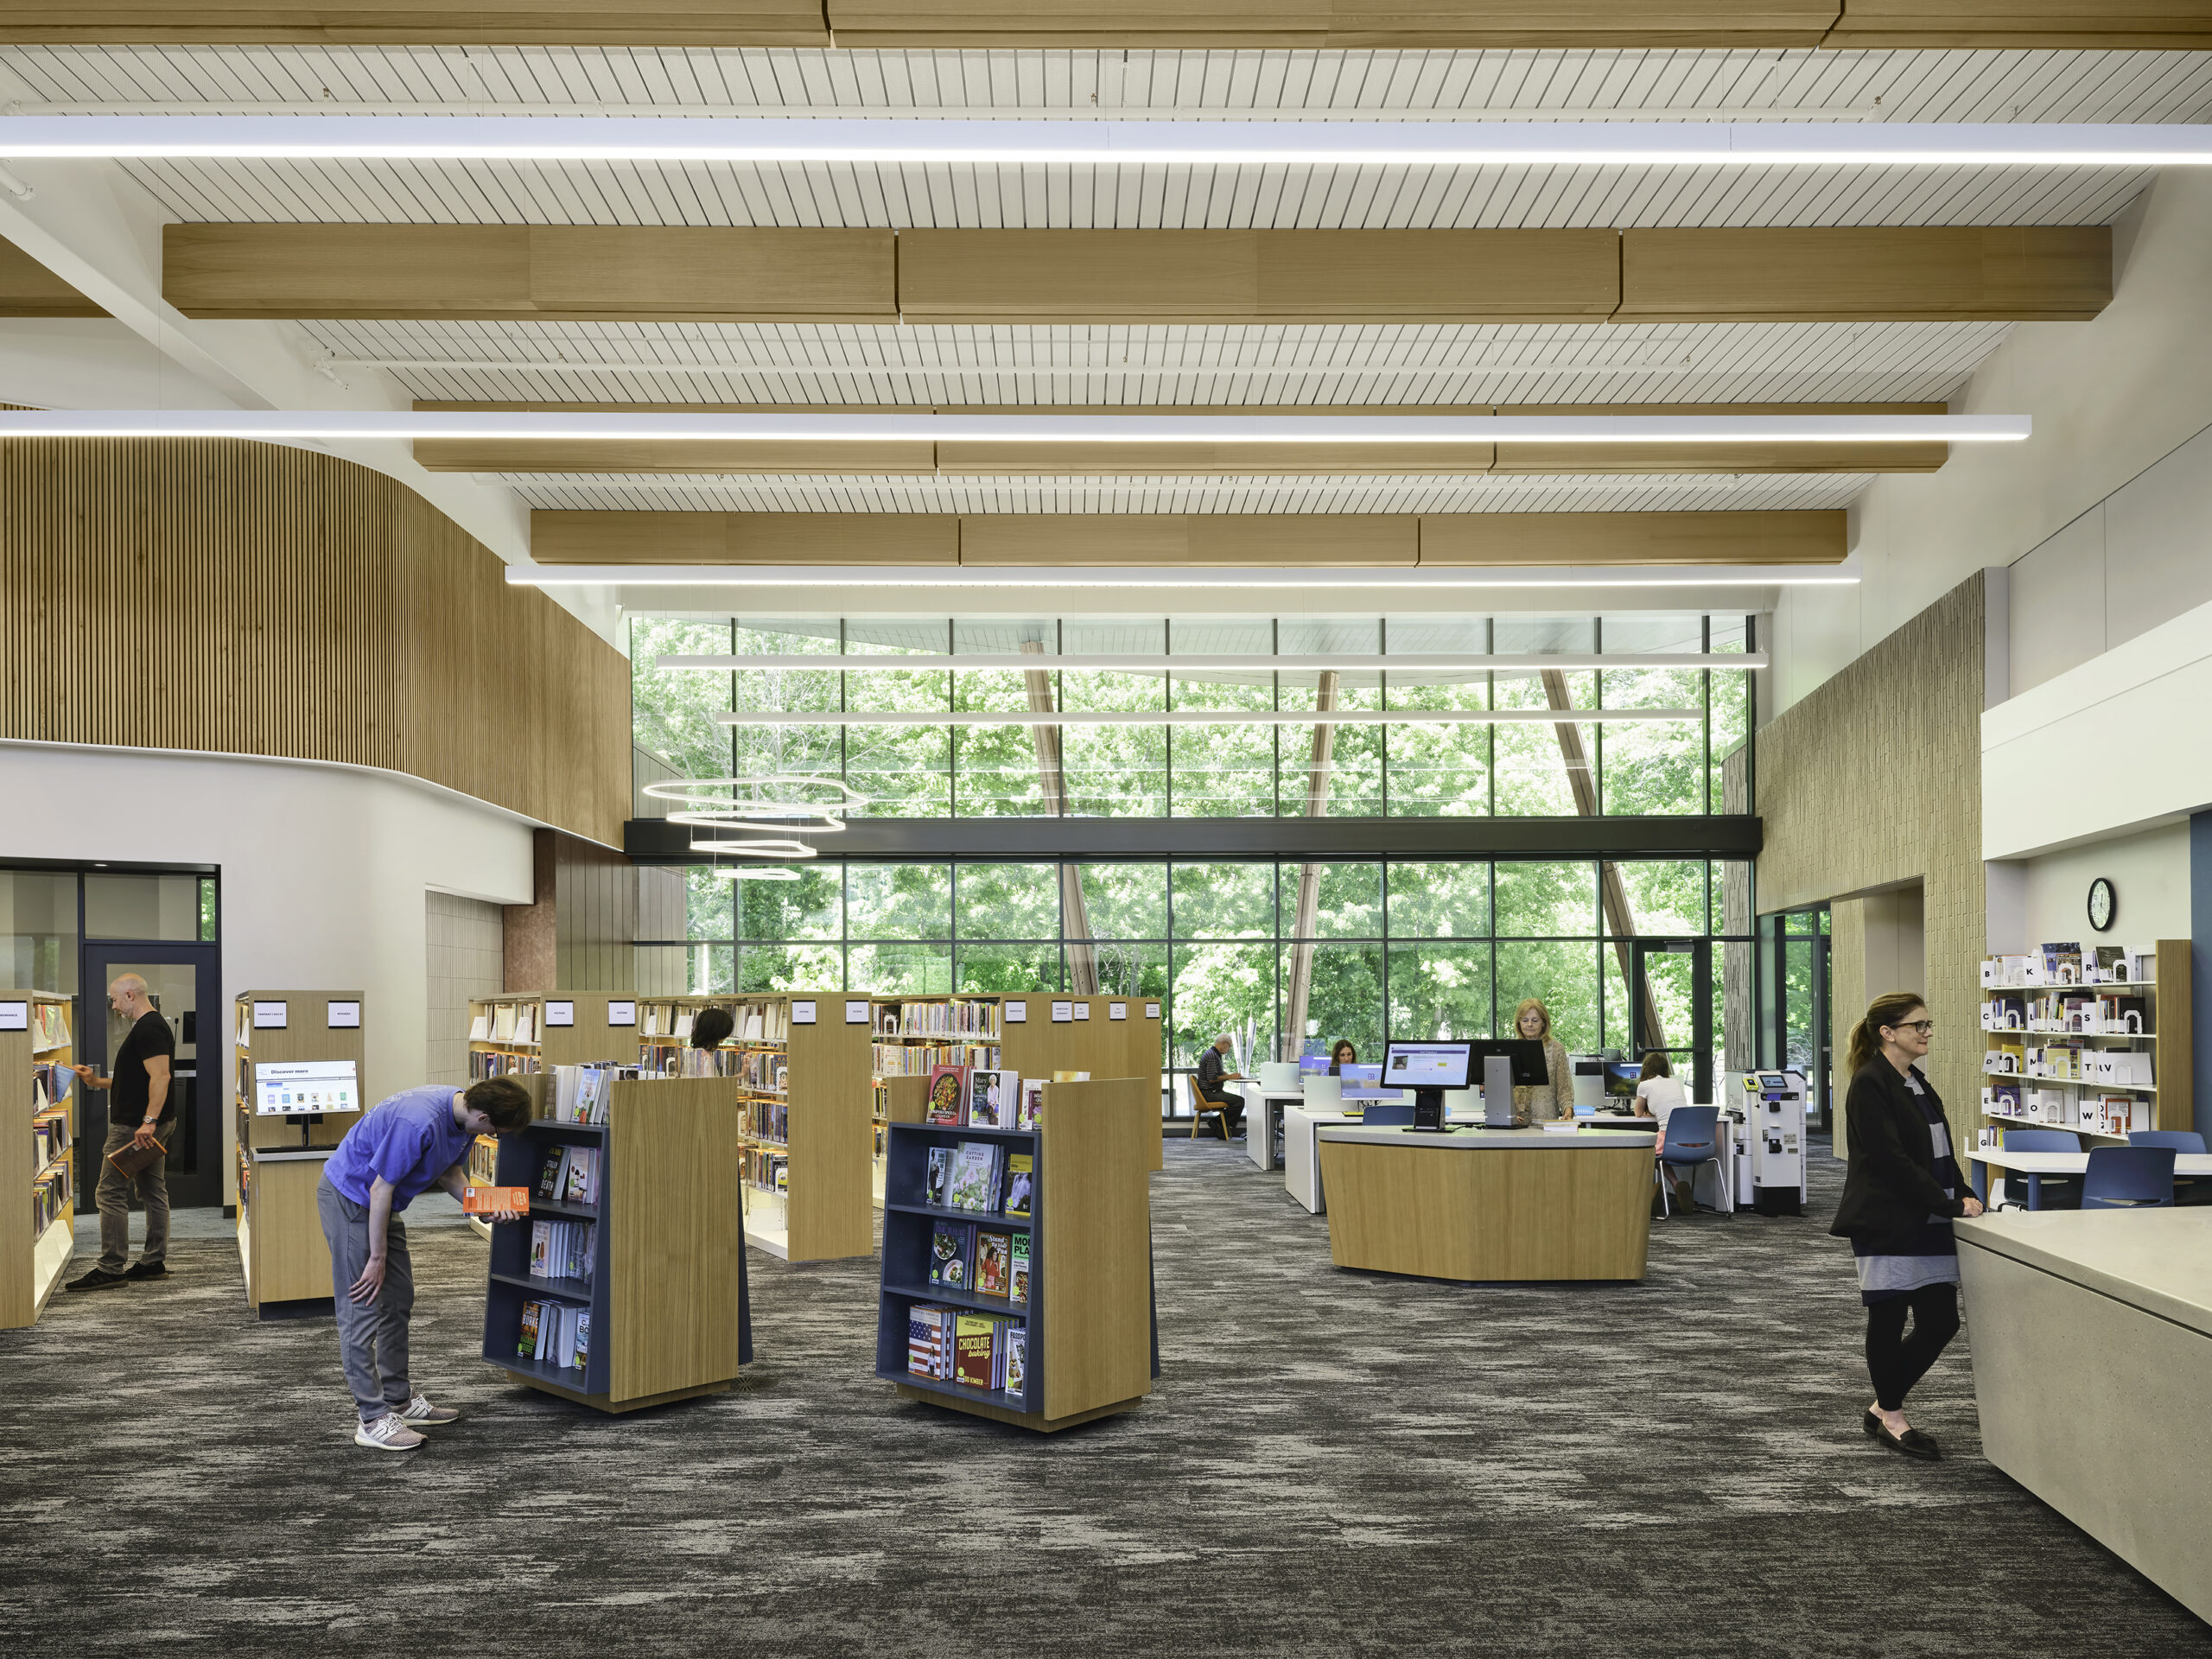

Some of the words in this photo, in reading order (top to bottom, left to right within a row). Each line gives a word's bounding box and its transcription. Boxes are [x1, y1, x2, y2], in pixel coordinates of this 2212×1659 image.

[958, 1337, 990, 1351] CHOCOLATE
[968, 1348, 990, 1359] baking
[969, 1376, 983, 1386] KIMBER
